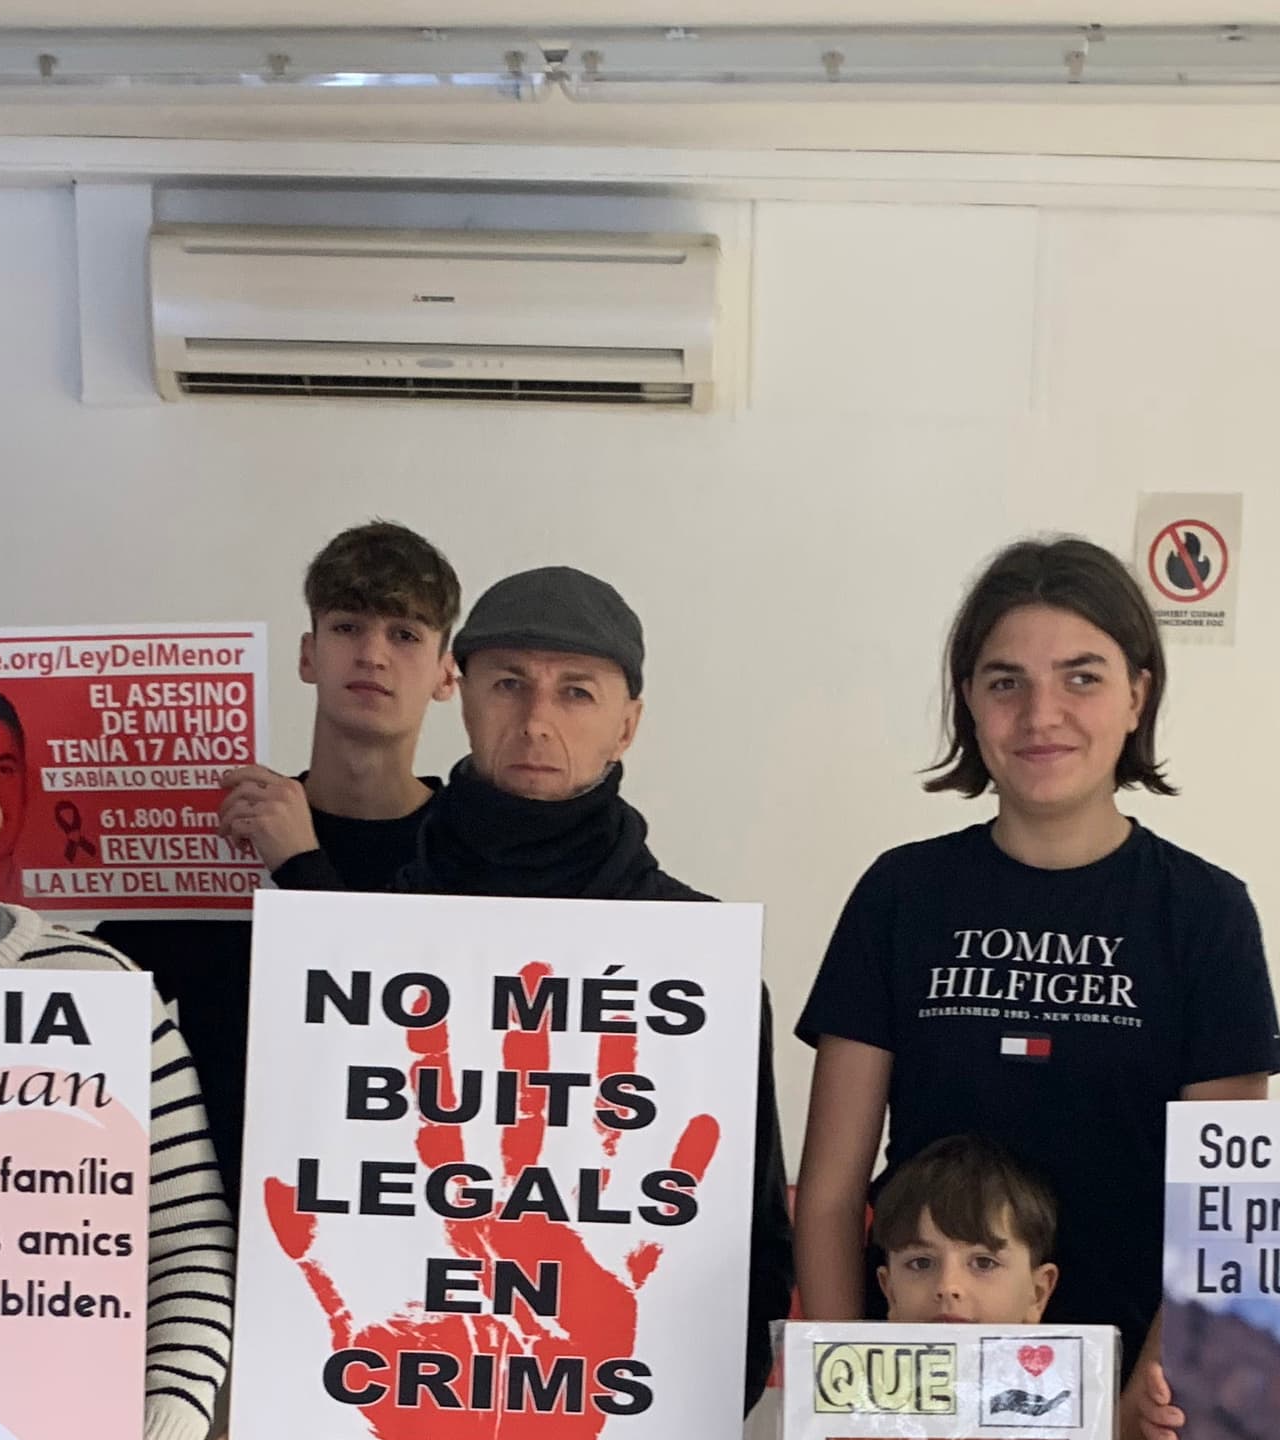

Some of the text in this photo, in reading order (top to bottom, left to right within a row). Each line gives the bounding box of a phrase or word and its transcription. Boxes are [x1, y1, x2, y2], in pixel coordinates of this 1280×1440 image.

[90, 681, 247, 708] EL ASESINO
[102, 709, 248, 735] DE MI HIJO
[47, 732, 249, 763] TENÍA 17 AÑOS
[45, 771, 56, 788] Y
[63, 768, 118, 788] SABÍA
[122, 770, 145, 787] LO
[151, 769, 190, 789] QUE
[100, 807, 177, 829] 61.800
[107, 836, 219, 862] REVISEN
[35, 871, 261, 894] LA LEY DEL MENOR
[954, 928, 1124, 967] TOMMY
[305, 965, 707, 1036] NO MÉS
[926, 967, 1138, 1008] HILFIGER
[918, 1006, 1001, 1019] ESTABLISHED
[1043, 1012, 1070, 1022] NEW
[1074, 1013, 1110, 1024] YORK
[1113, 1014, 1144, 1028] CITY
[345, 1065, 657, 1130] BUITS
[1199, 1123, 1272, 1169] Soc
[0, 1156, 134, 1196] família
[295, 1158, 698, 1226] LEGALS
[1198, 1185, 1232, 1231] El
[19, 1220, 132, 1257] amics
[425, 1257, 560, 1317] EN
[1197, 1249, 1241, 1295] La
[322, 1348, 654, 1416] CRIMS
